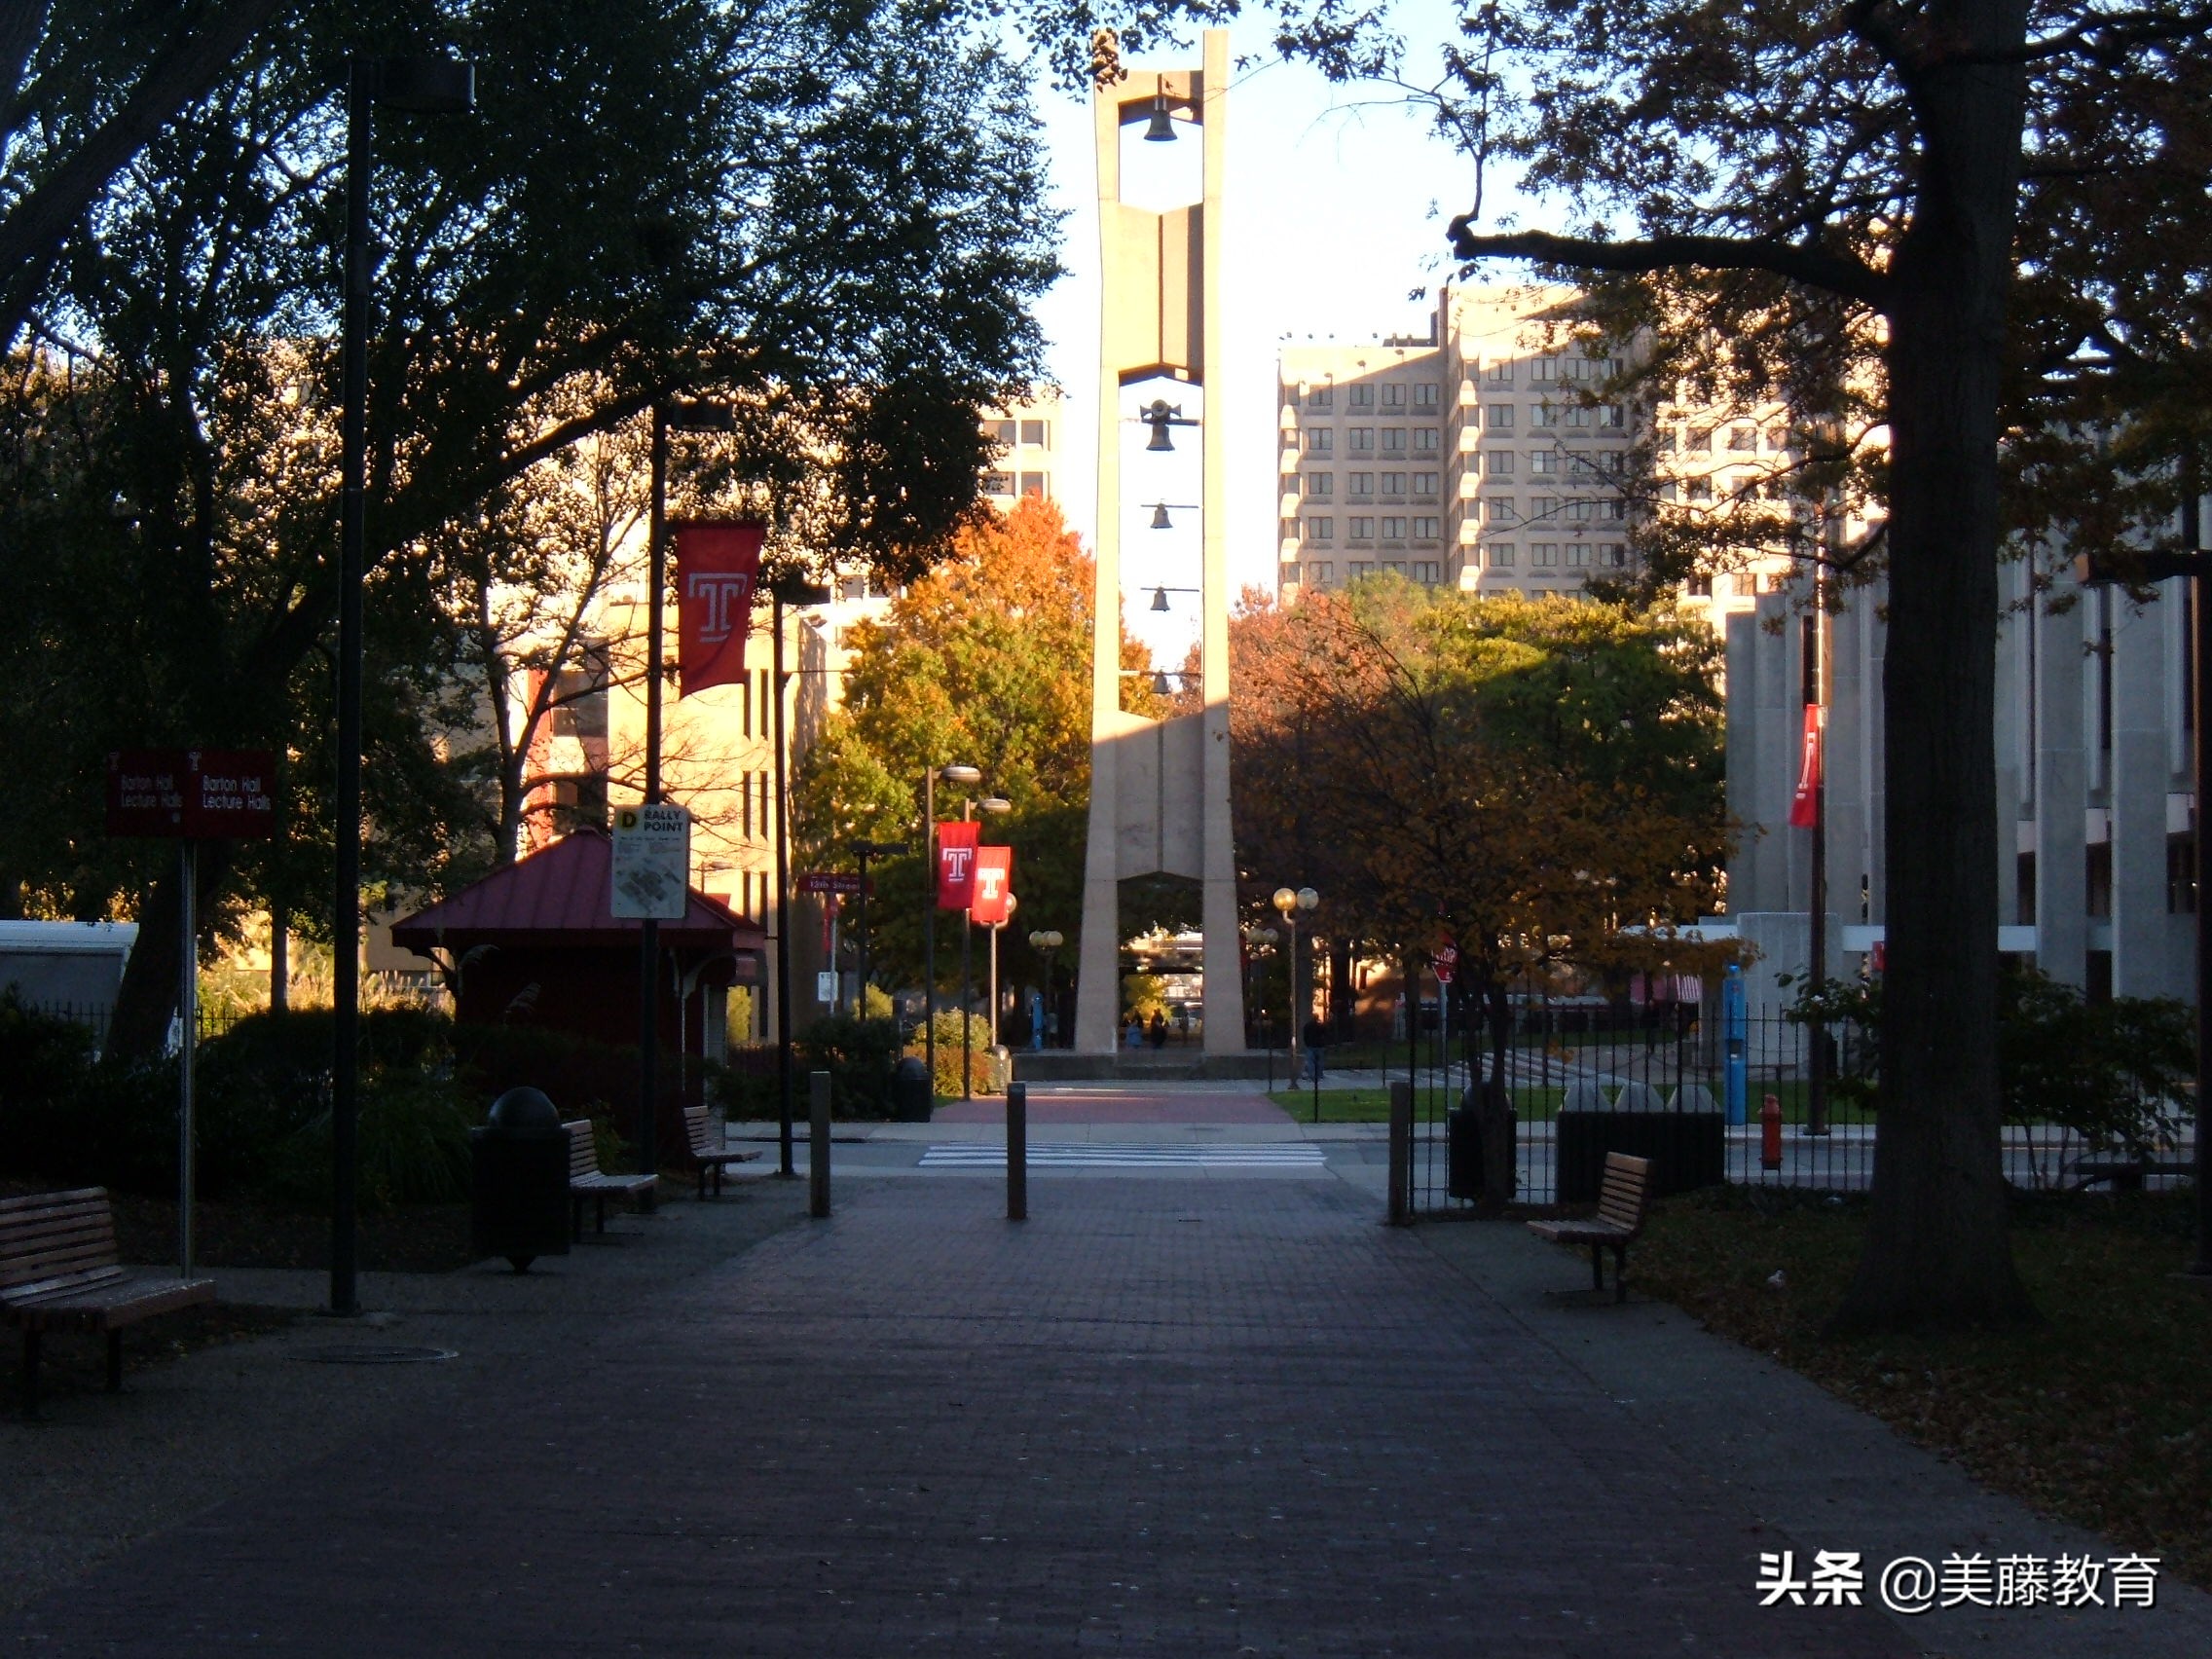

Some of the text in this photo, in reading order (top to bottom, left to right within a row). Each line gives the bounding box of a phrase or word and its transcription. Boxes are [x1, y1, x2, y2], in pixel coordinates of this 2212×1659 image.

[688, 572, 748, 643] T
[203, 775, 261, 793] Barton Hall
[203, 793, 271, 810] Lecture Halls
[622, 812, 636, 827] D
[644, 810, 681, 821] RALLY
[644, 822, 683, 831] POINT
[942, 848, 972, 882] T
[977, 867, 1006, 900] T
